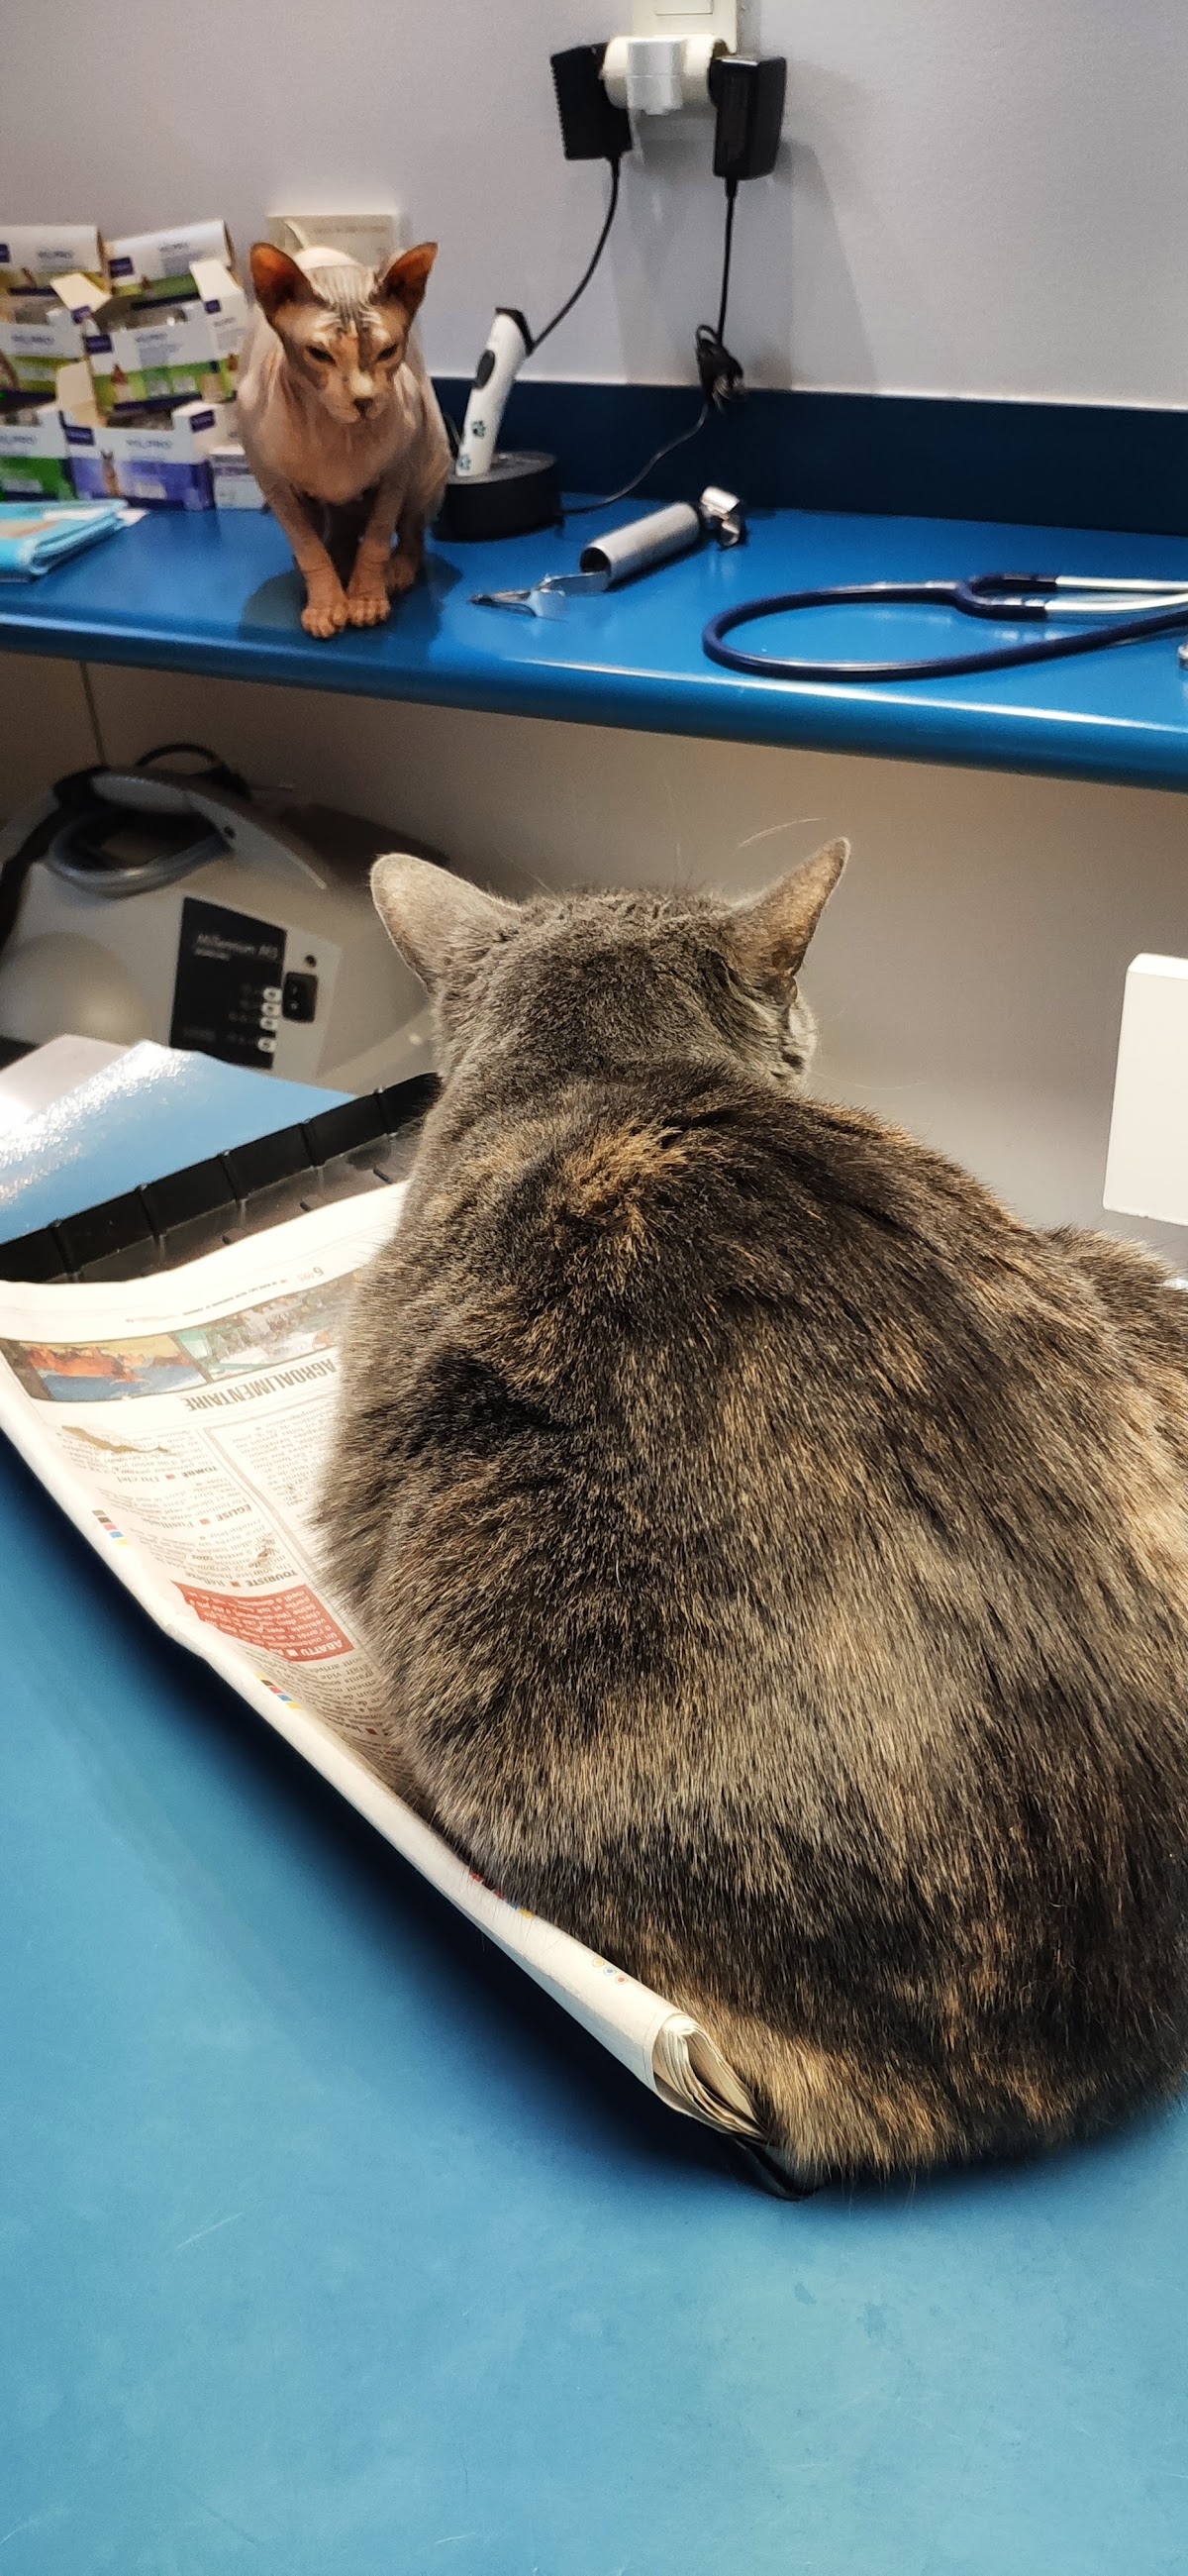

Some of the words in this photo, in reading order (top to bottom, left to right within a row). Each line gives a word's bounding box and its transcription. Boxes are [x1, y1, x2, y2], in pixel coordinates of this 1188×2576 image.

[183, 1358, 338, 1412] AGROALIMENTAIRE
[246, 1569, 298, 1588] TOURISTE
[300, 1639, 343, 1657] ABATTU
